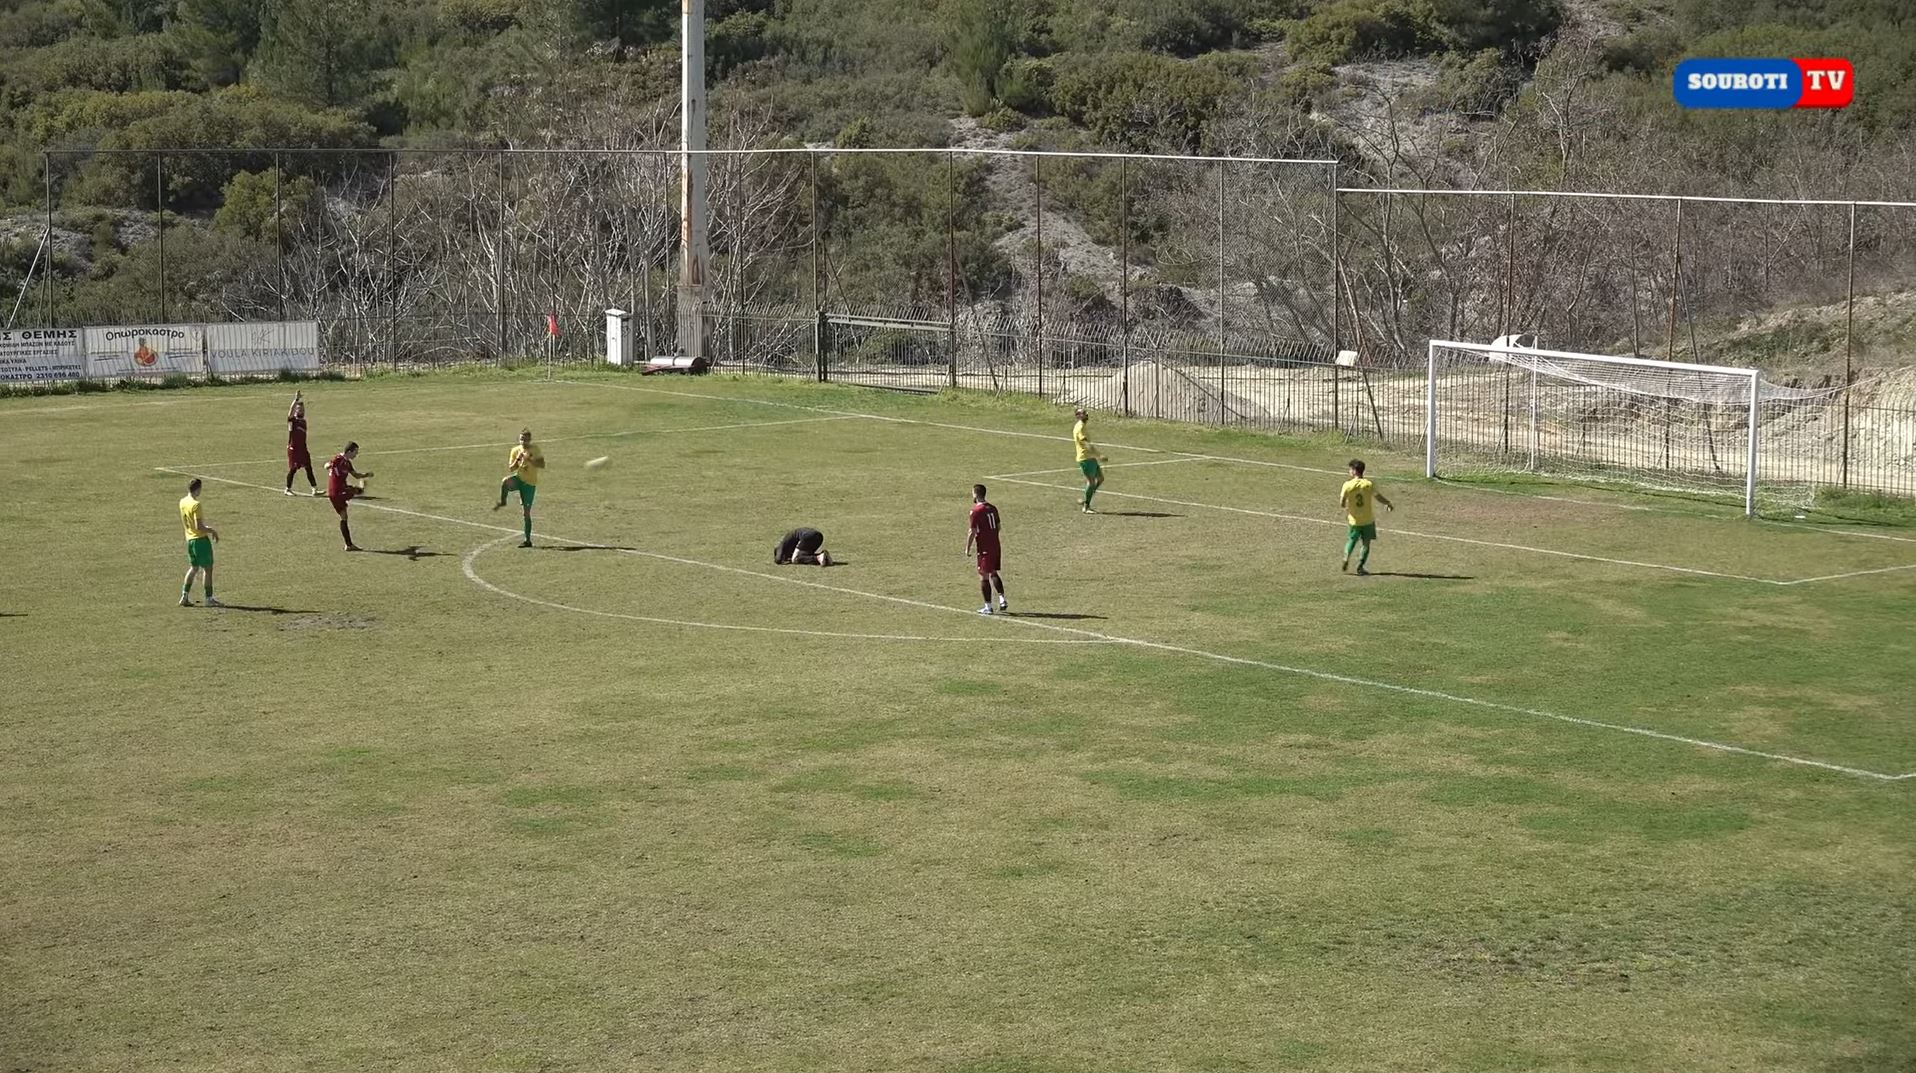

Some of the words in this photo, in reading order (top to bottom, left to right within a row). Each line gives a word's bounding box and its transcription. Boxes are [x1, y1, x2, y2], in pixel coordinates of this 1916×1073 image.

[22, 330, 77, 339] ΘΕΜΗΣ
[211, 350, 248, 359] VOULA
[251, 347, 315, 358] KIRIAKIDOU
[1356, 493, 1365, 507] 3
[987, 512, 996, 529] 11
